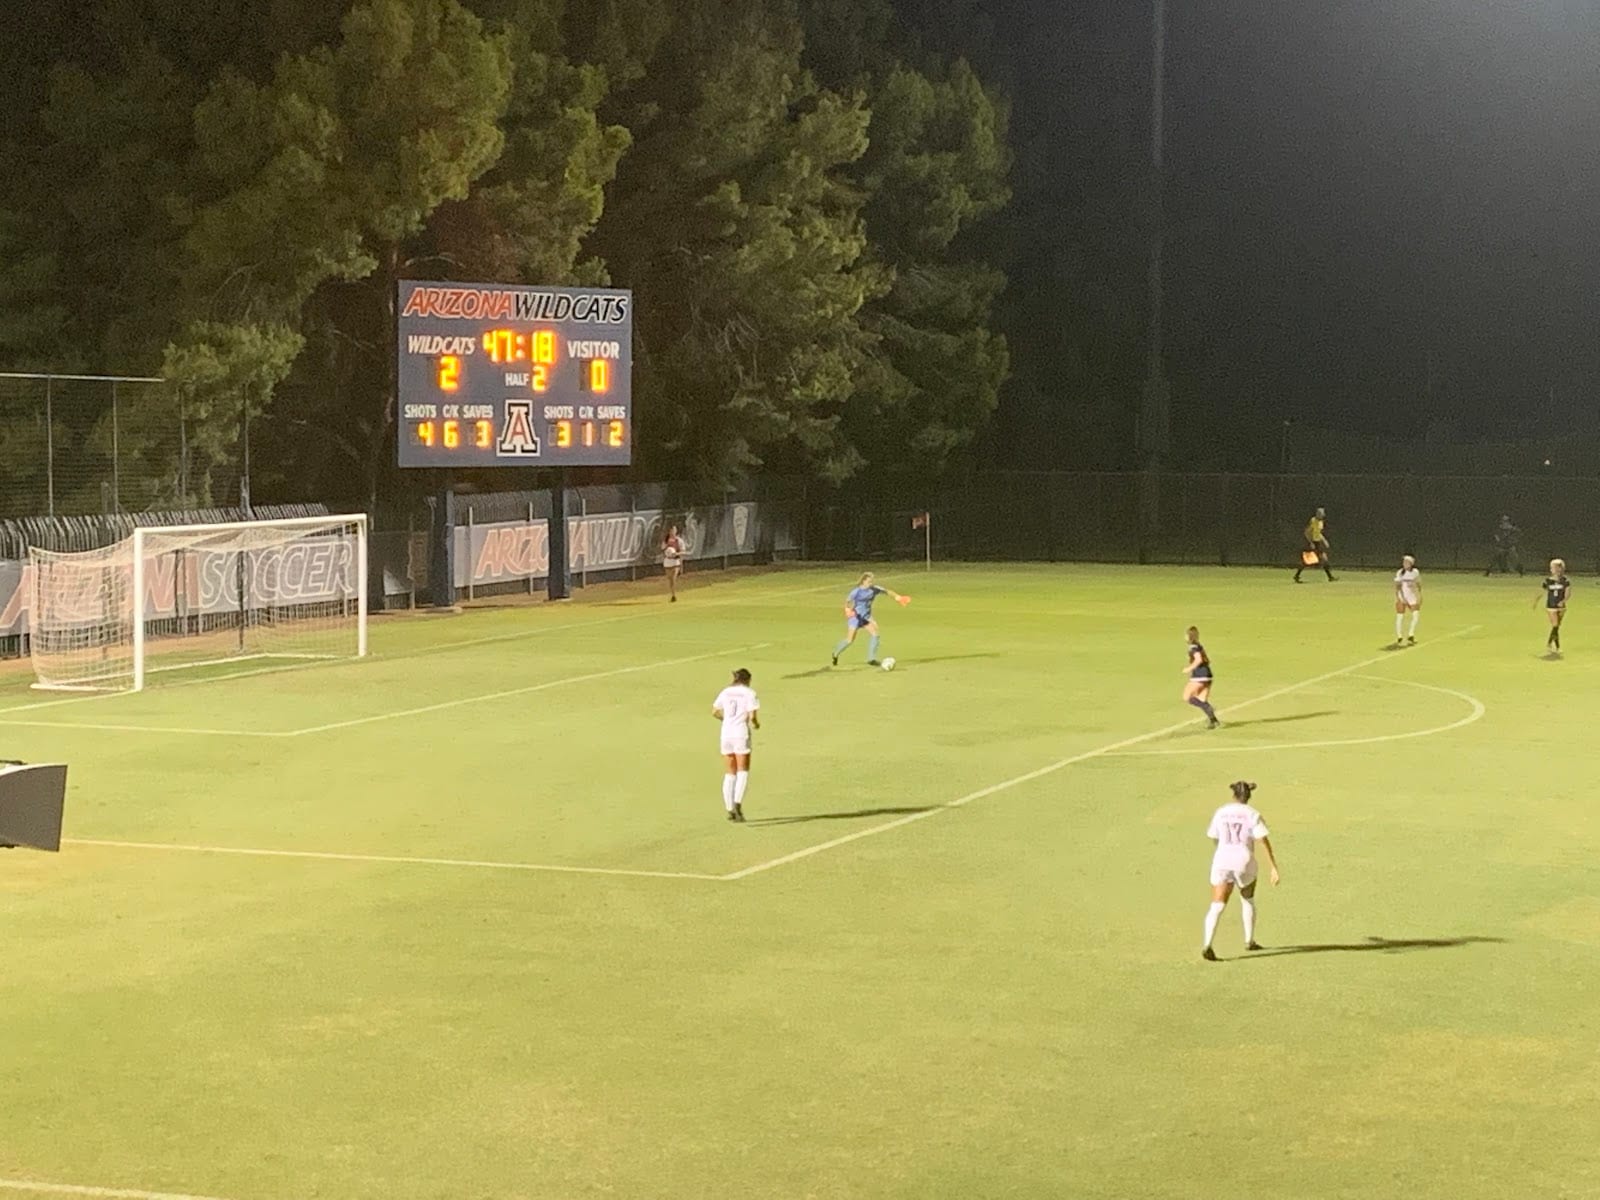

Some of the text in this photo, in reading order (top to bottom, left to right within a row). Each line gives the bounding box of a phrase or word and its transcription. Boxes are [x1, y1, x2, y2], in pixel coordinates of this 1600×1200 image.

[402, 287, 628, 322] ARIZONA WILDCATS
[408, 335, 476, 354] WILDCATS
[482, 329, 557, 363] 47:18
[567, 341, 620, 359] VISITOR
[439, 355, 459, 391] 2
[505, 373, 530, 387] HALF
[532, 365, 547, 392] 2
[590, 359, 608, 393] 0
[404, 404, 437, 419] SHOTS
[463, 404, 494, 418] SAVES
[544, 405, 574, 419] SHOTS
[597, 405, 626, 419] SAVES
[418, 421, 492, 448] 4 6 3
[496, 399, 541, 457] A
[557, 421, 624, 448] 3 1 2
[474, 520, 590, 579] ARIZOA
[200, 540, 354, 608] SOCCER
[1224, 822, 1243, 845] 17
